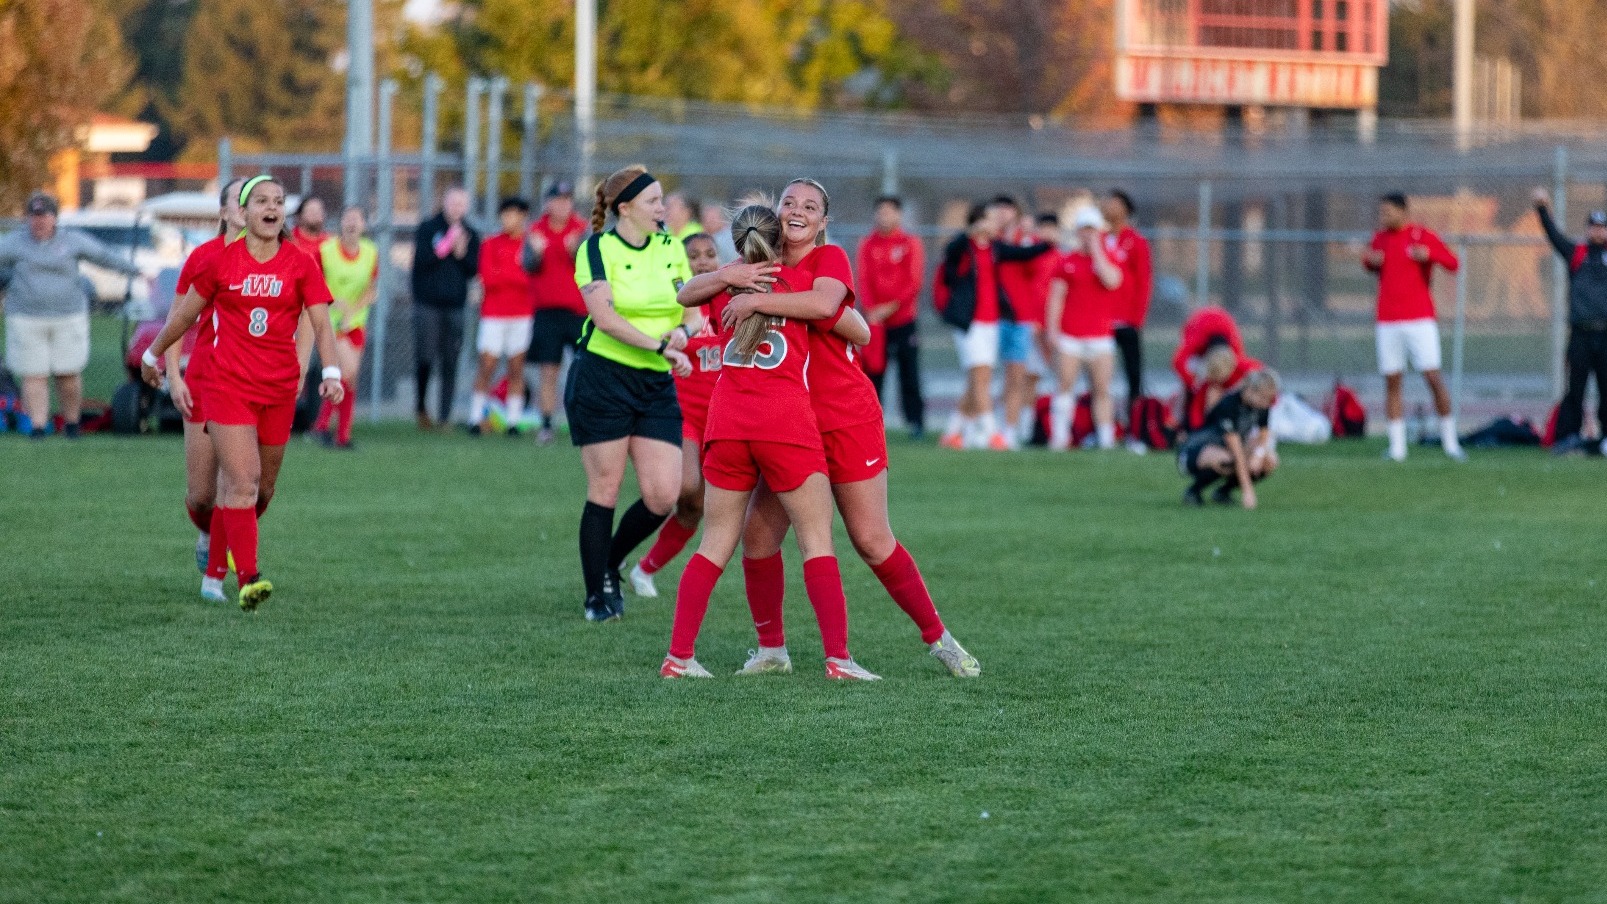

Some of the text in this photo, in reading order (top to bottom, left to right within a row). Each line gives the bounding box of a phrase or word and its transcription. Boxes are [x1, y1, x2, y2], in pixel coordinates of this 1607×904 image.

[241, 274, 283, 297] IWU
[248, 307, 268, 337] 8
[696, 345, 722, 372] 19
